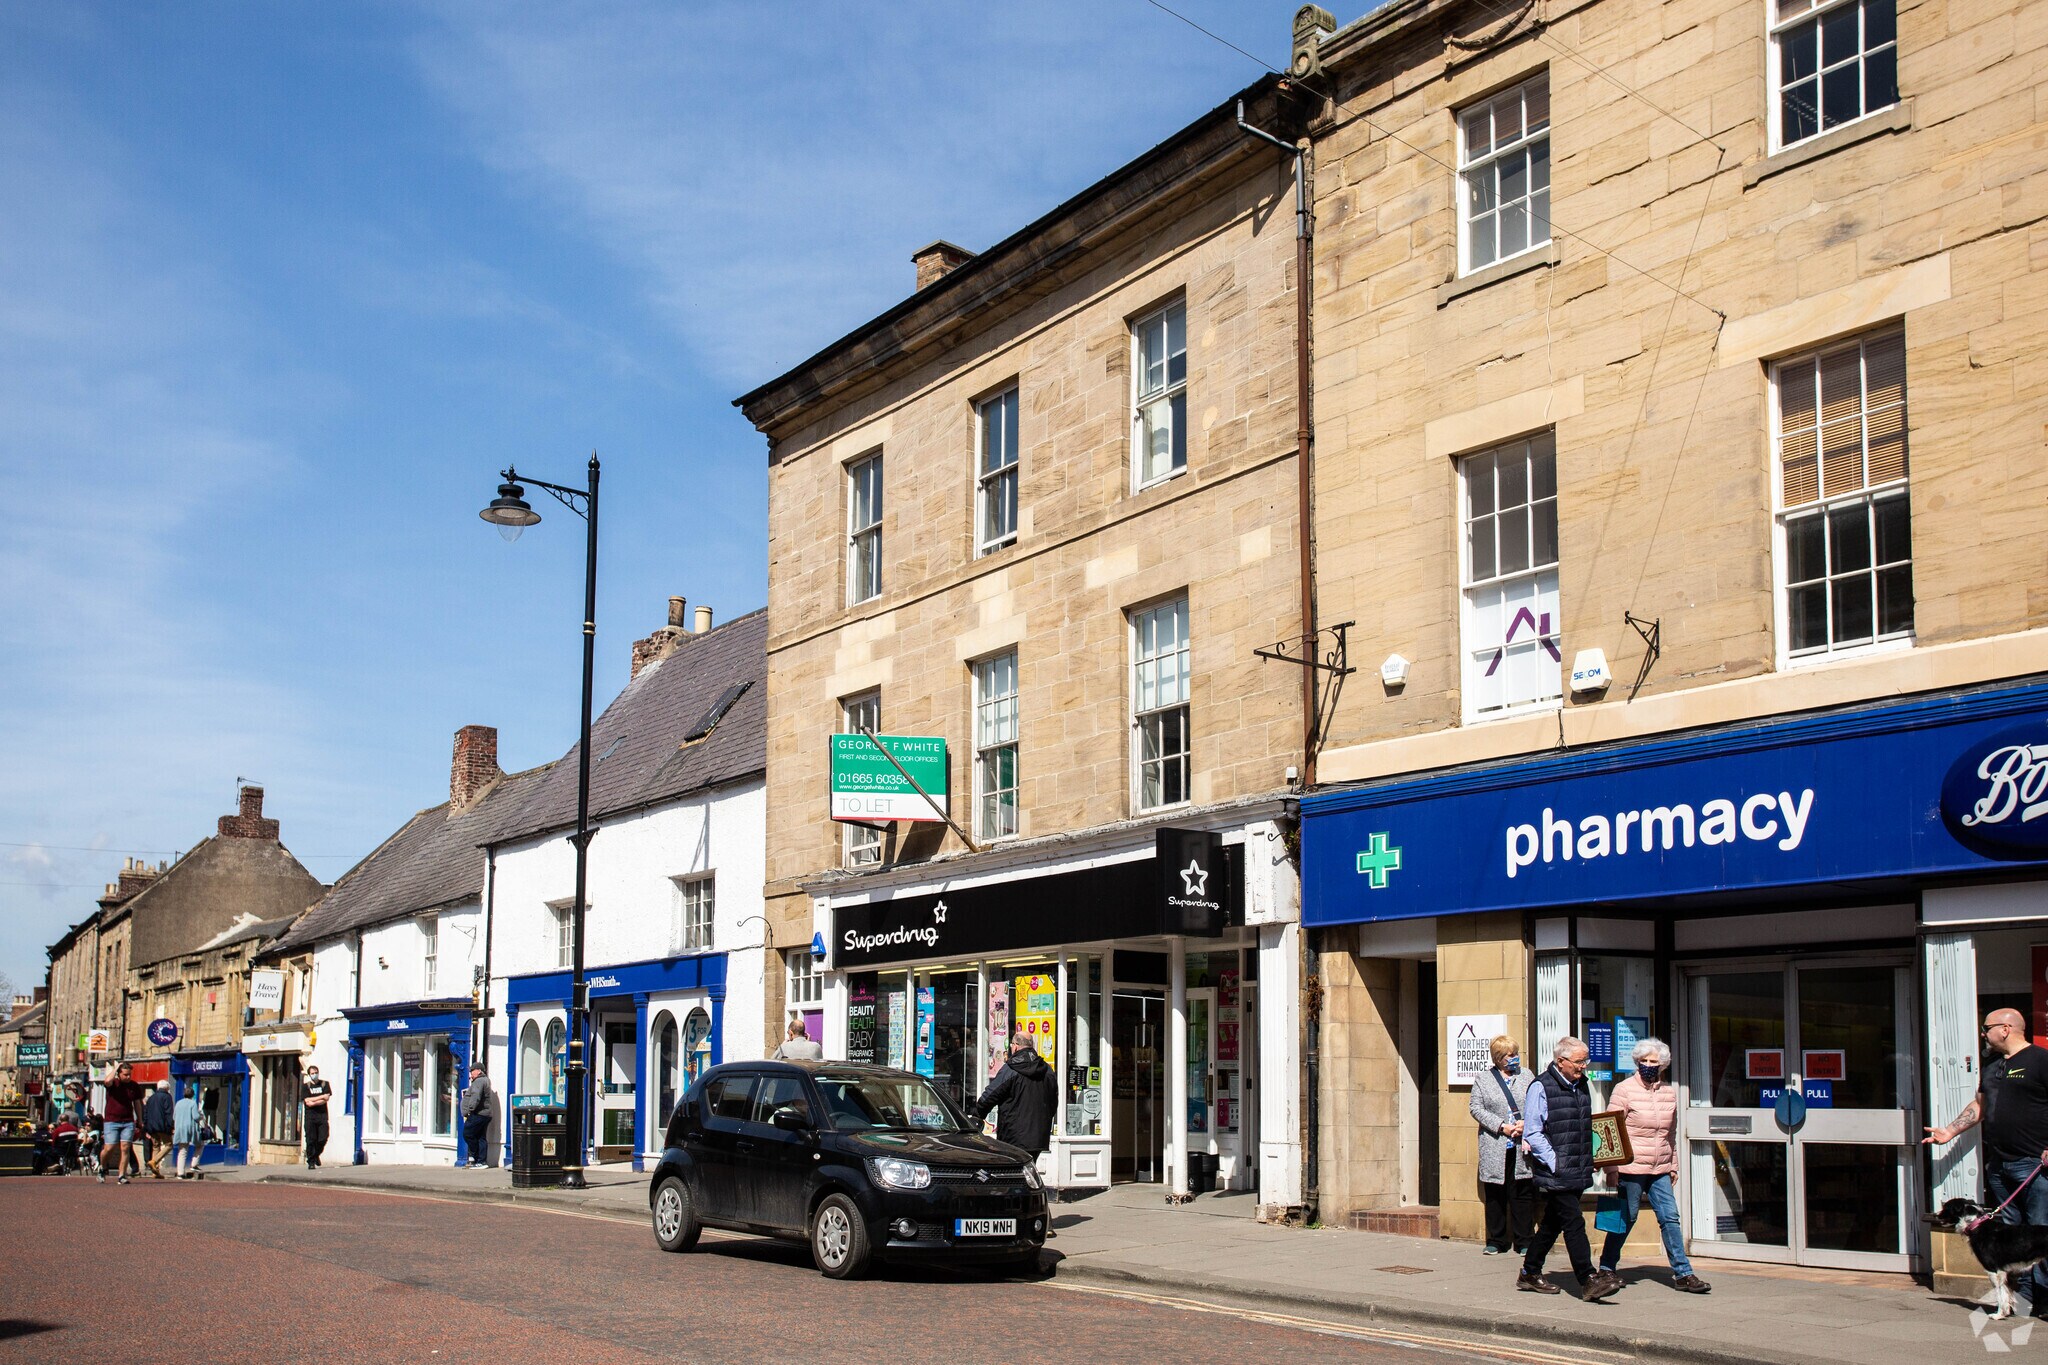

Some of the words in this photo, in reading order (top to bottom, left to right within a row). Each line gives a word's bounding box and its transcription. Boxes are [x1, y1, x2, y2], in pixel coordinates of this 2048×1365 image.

[1573, 667, 1601, 681] SECOM
[838, 740, 887, 750] GEORGE
[893, 742, 900, 750] F
[903, 742, 940, 752] WHITE
[838, 772, 872, 784] 01665
[1961, 743, 2048, 827] Bo
[839, 798, 862, 812] TO
[866, 798, 894, 813] LET
[1505, 789, 1814, 878] pharmacy
[1168, 896, 1220, 910] Superdrug
[844, 925, 939, 953] Superdrug
[257, 983, 277, 992] Hays
[254, 991, 280, 999] Travel
[849, 1005, 875, 1016] BEAUTY
[848, 1016, 874, 1030] HEALTH
[688, 1018, 698, 1043] 3
[848, 1031, 874, 1048] BABY
[1457, 1038, 1491, 1049] NORTHER
[1457, 1050, 1489, 1060] PROPERT
[1457, 1061, 1488, 1072] FINANCE
[1807, 1090, 1829, 1098] PULL
[965, 1221, 990, 1233] NK19
[993, 1221, 1013, 1233] WNH
